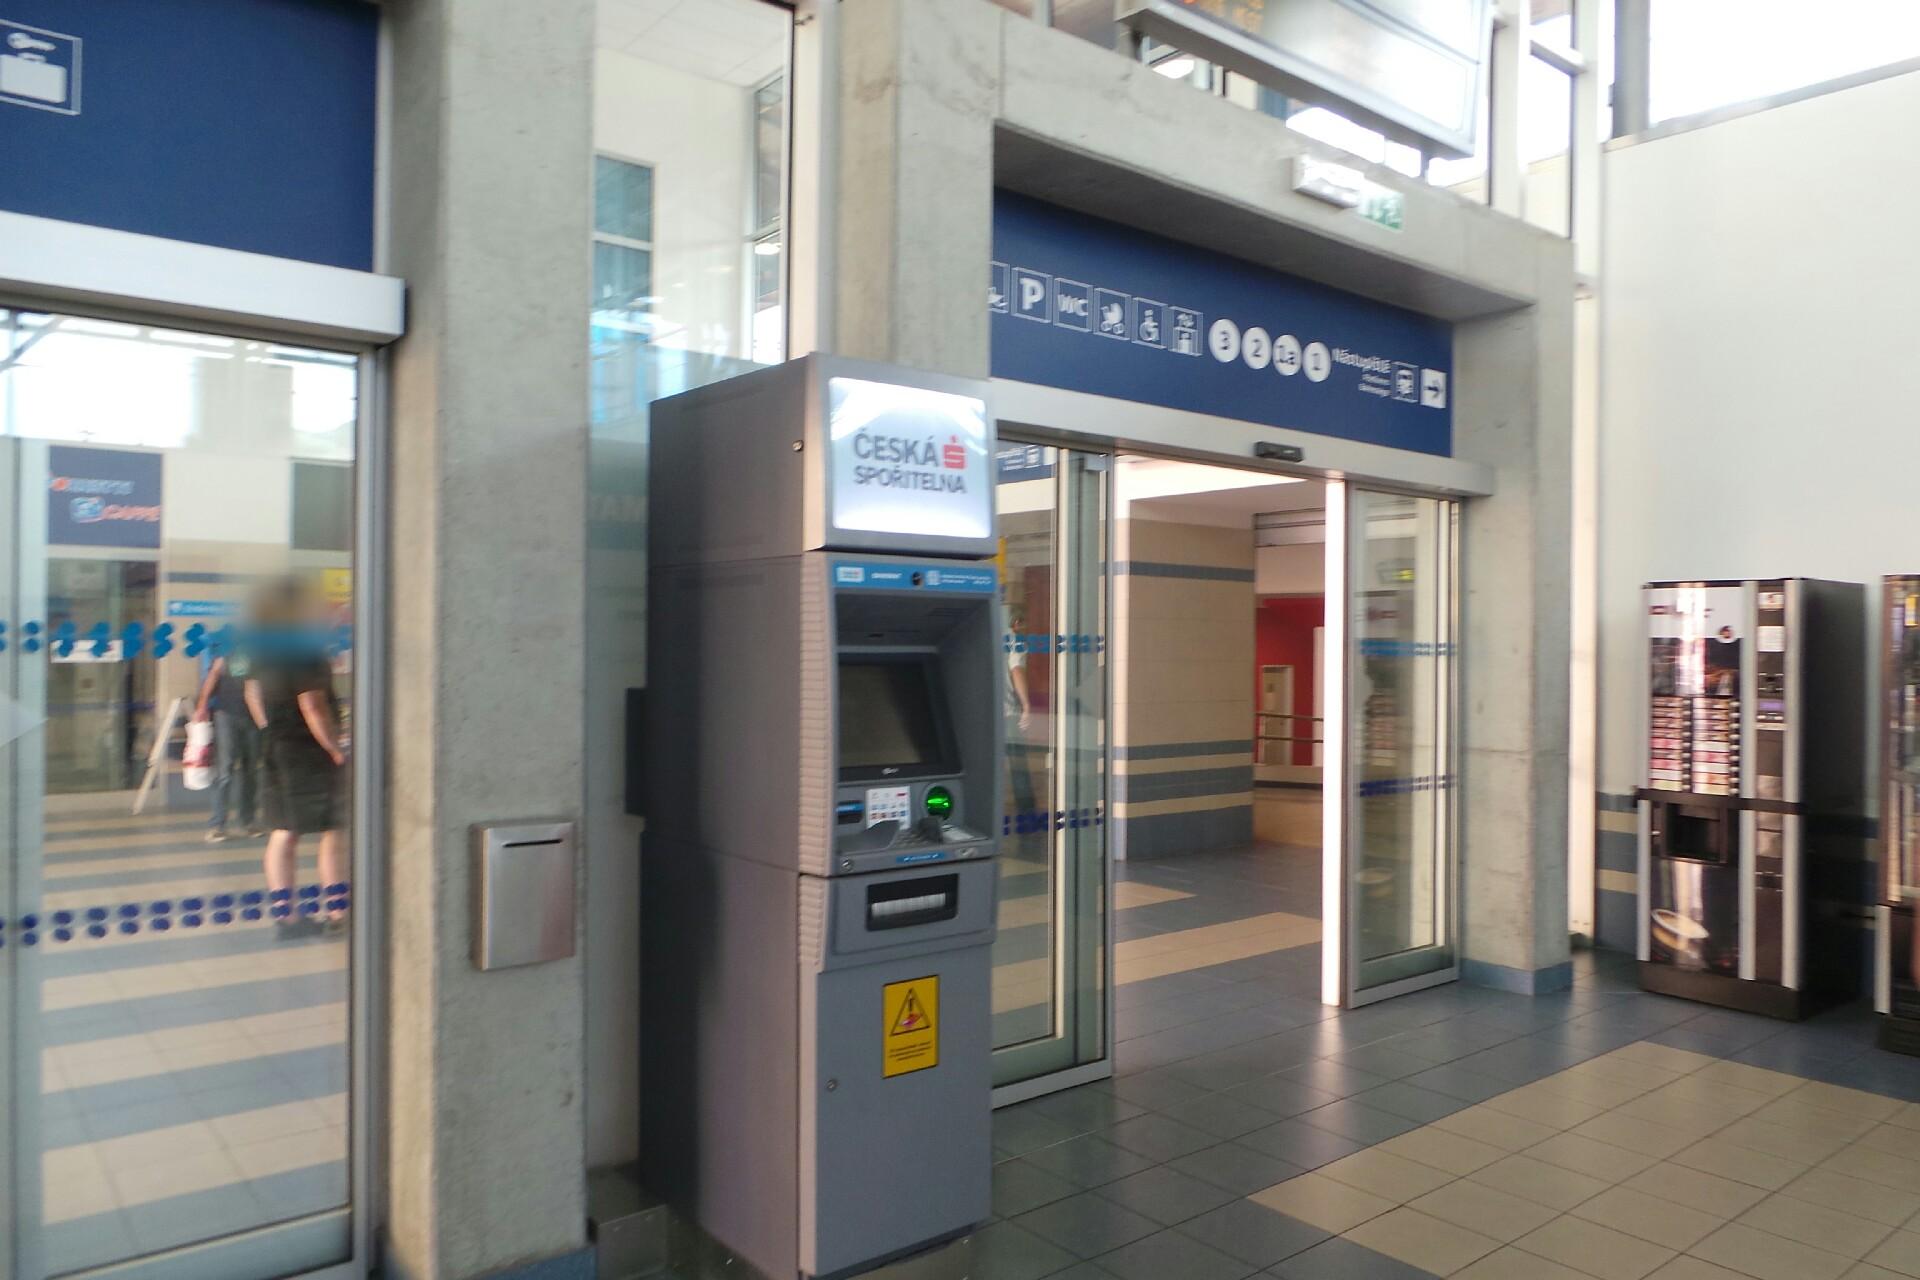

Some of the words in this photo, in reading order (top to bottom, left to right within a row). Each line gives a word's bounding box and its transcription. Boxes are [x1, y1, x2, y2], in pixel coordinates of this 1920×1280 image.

[1020, 277, 1045, 310] P
[1057, 293, 1089, 317] WC
[854, 427, 940, 468] ČESKÁ
[853, 464, 967, 494] SPOŘITELNA
